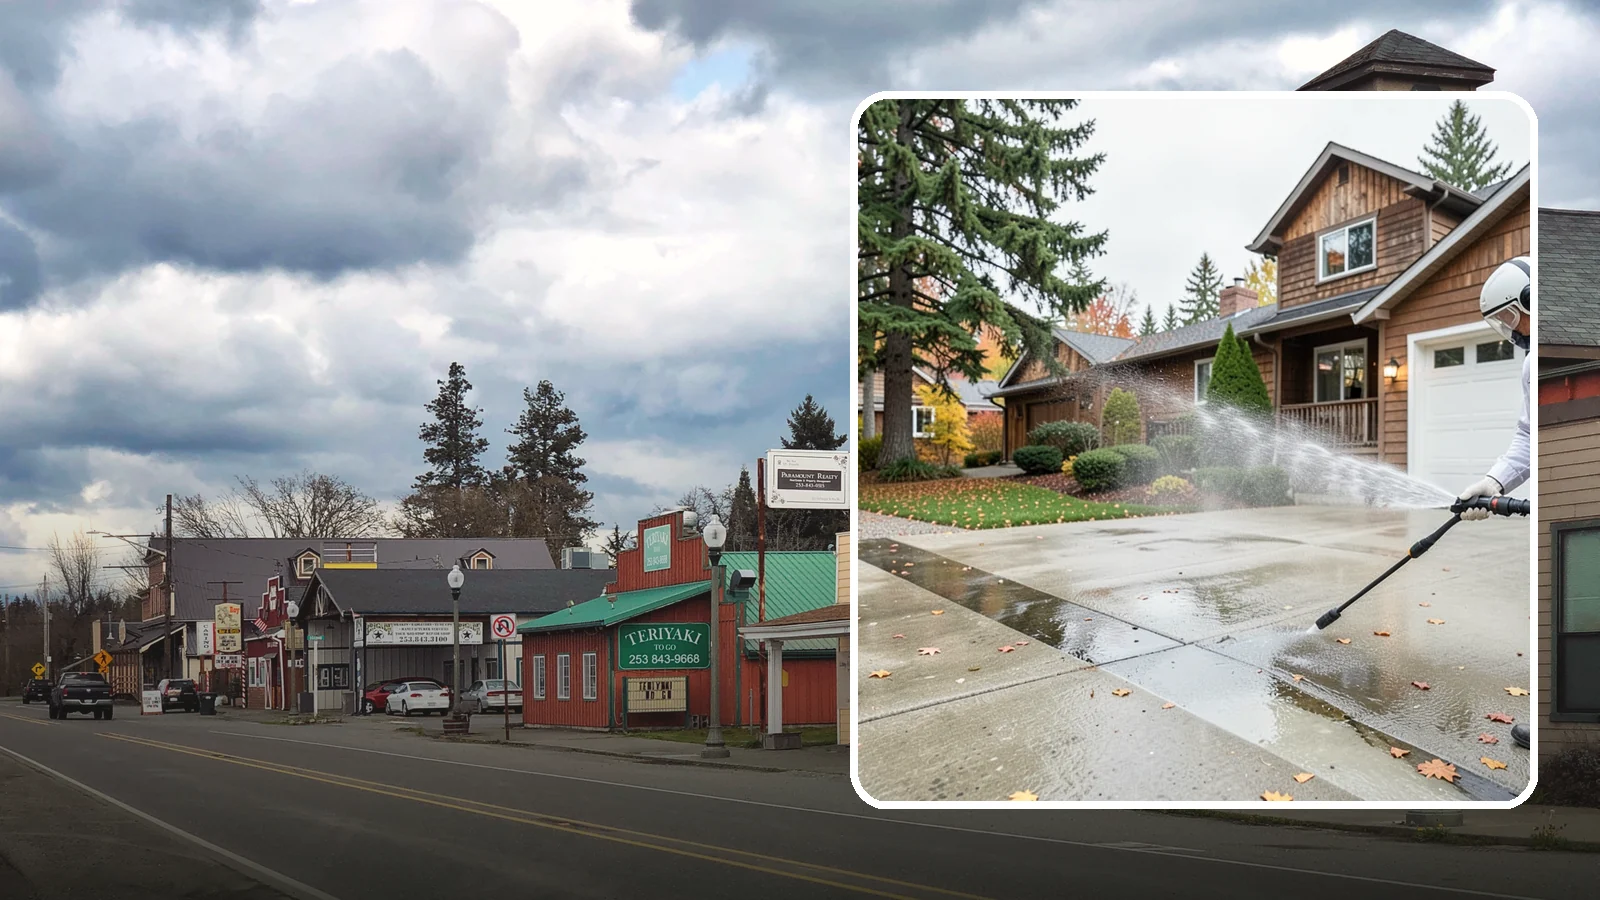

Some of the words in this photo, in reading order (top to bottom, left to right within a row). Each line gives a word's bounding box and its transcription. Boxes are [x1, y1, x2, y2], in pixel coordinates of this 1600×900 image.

[781, 471, 815, 479] PARAMOUNT
[817, 472, 839, 480] REALTY
[625, 627, 702, 646] TERIYAKI
[629, 654, 649, 664] 253
[651, 653, 700, 664] 843-9668
